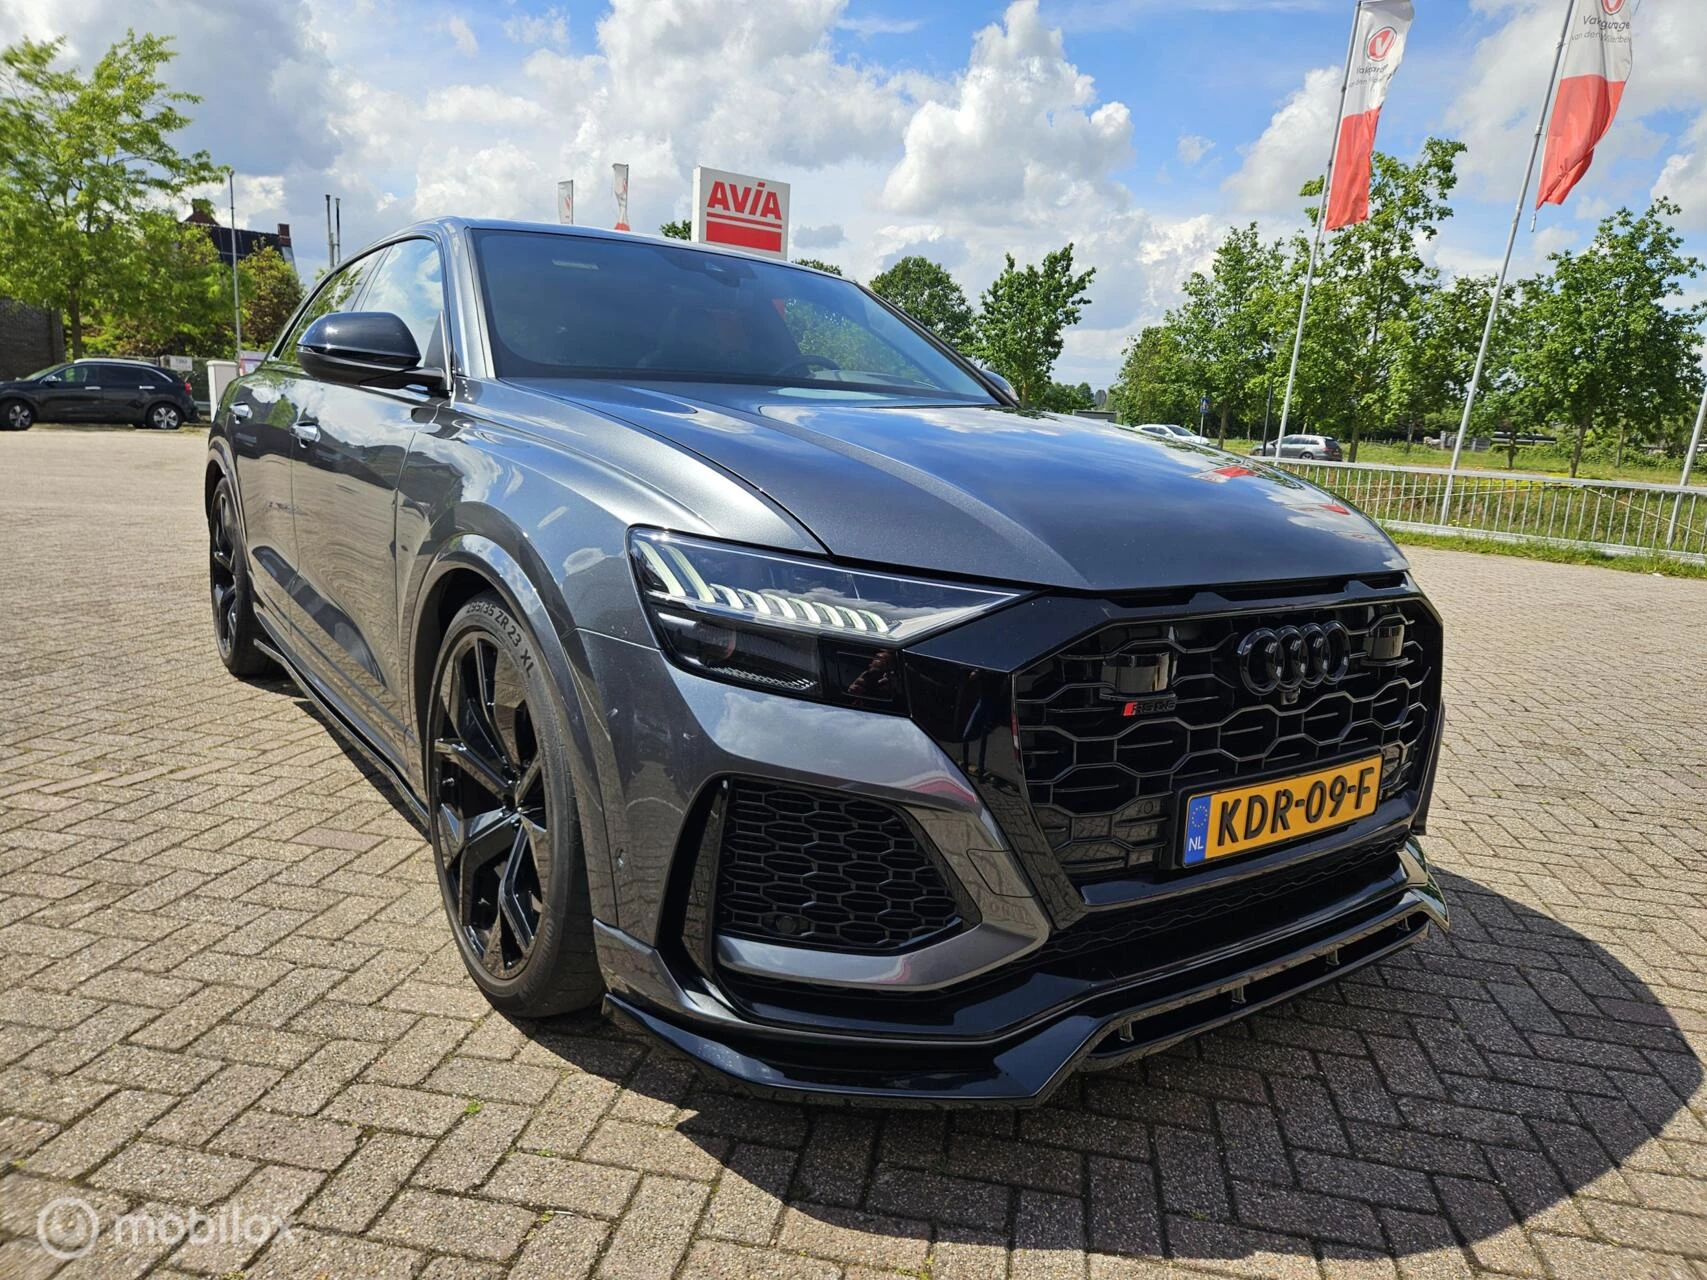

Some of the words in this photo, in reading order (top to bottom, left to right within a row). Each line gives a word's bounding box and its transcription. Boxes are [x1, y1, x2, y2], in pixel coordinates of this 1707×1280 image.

[495, 610, 509, 631] ZR
[507, 625, 522, 647] 23
[520, 648, 534, 679] XL
[1217, 766, 1375, 846] KDR-09-F
[1188, 836, 1204, 851] NL
